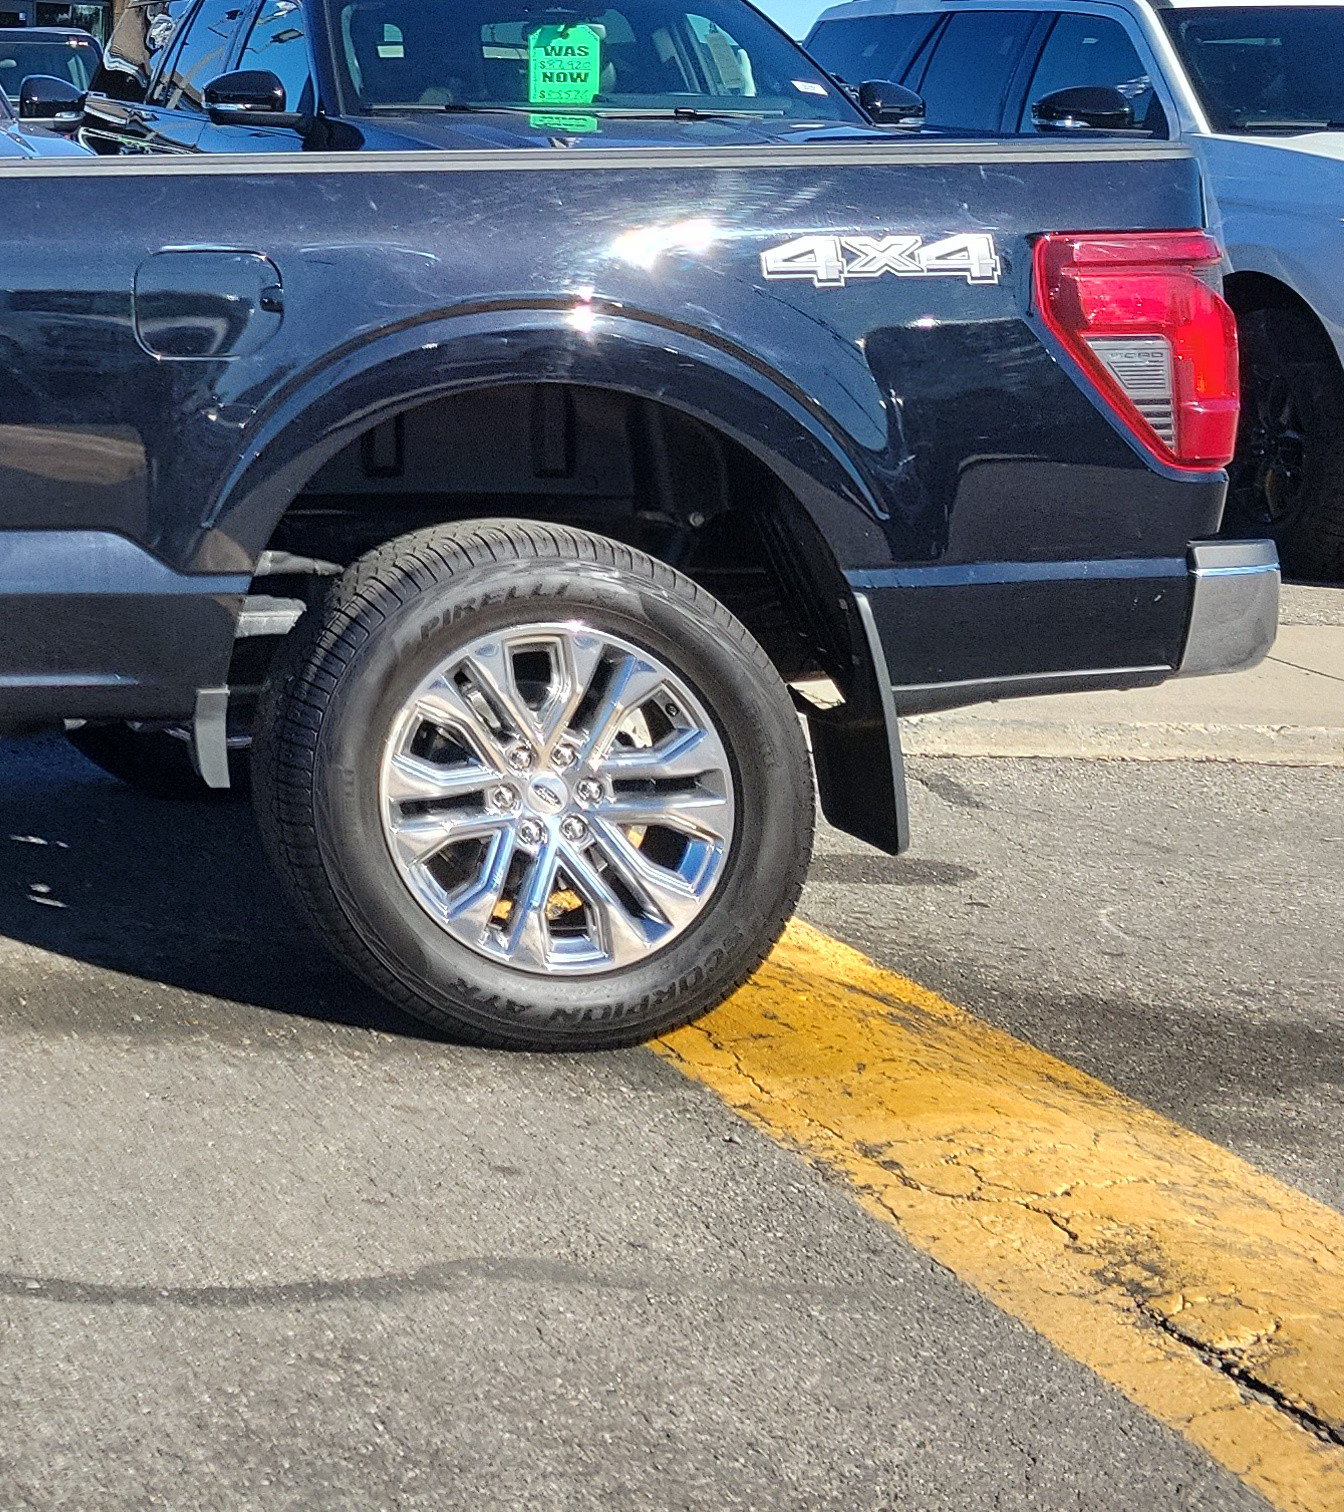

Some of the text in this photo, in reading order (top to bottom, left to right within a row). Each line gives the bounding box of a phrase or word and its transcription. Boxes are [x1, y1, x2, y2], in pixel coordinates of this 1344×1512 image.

[543, 46, 590, 57] WAS
[542, 72, 589, 83] NOW
[420, 582, 569, 639] PIRELLI
